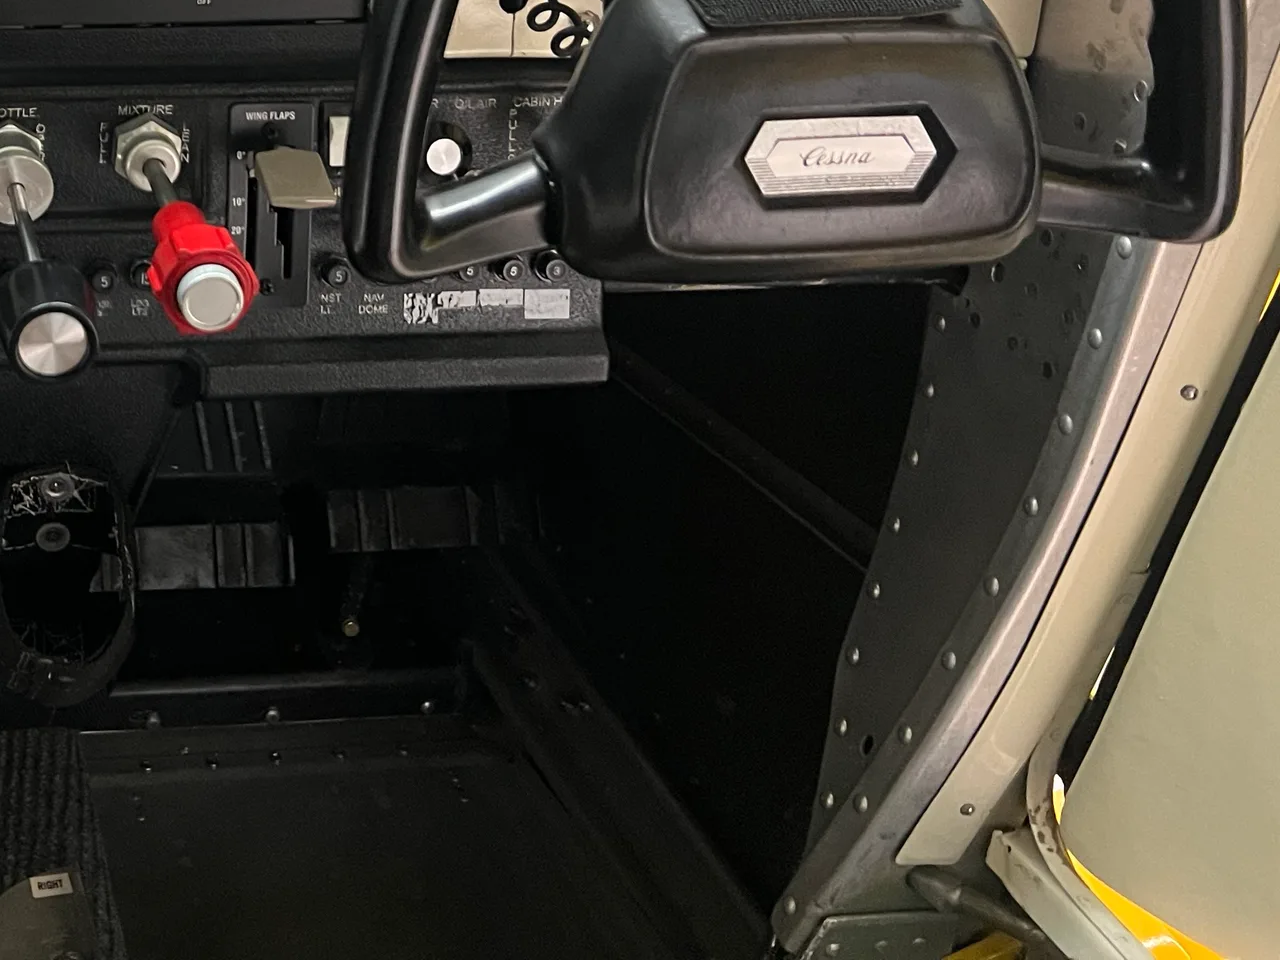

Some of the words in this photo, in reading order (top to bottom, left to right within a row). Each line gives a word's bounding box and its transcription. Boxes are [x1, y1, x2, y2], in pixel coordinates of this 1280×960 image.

[514, 97, 551, 107] CABIN
[118, 105, 174, 116] MIXTURE
[246, 112, 268, 120] WING
[270, 111, 296, 120] FLAPS
[800, 146, 873, 167] Cessna
[363, 293, 385, 302] NAV
[359, 305, 388, 315] DOME
